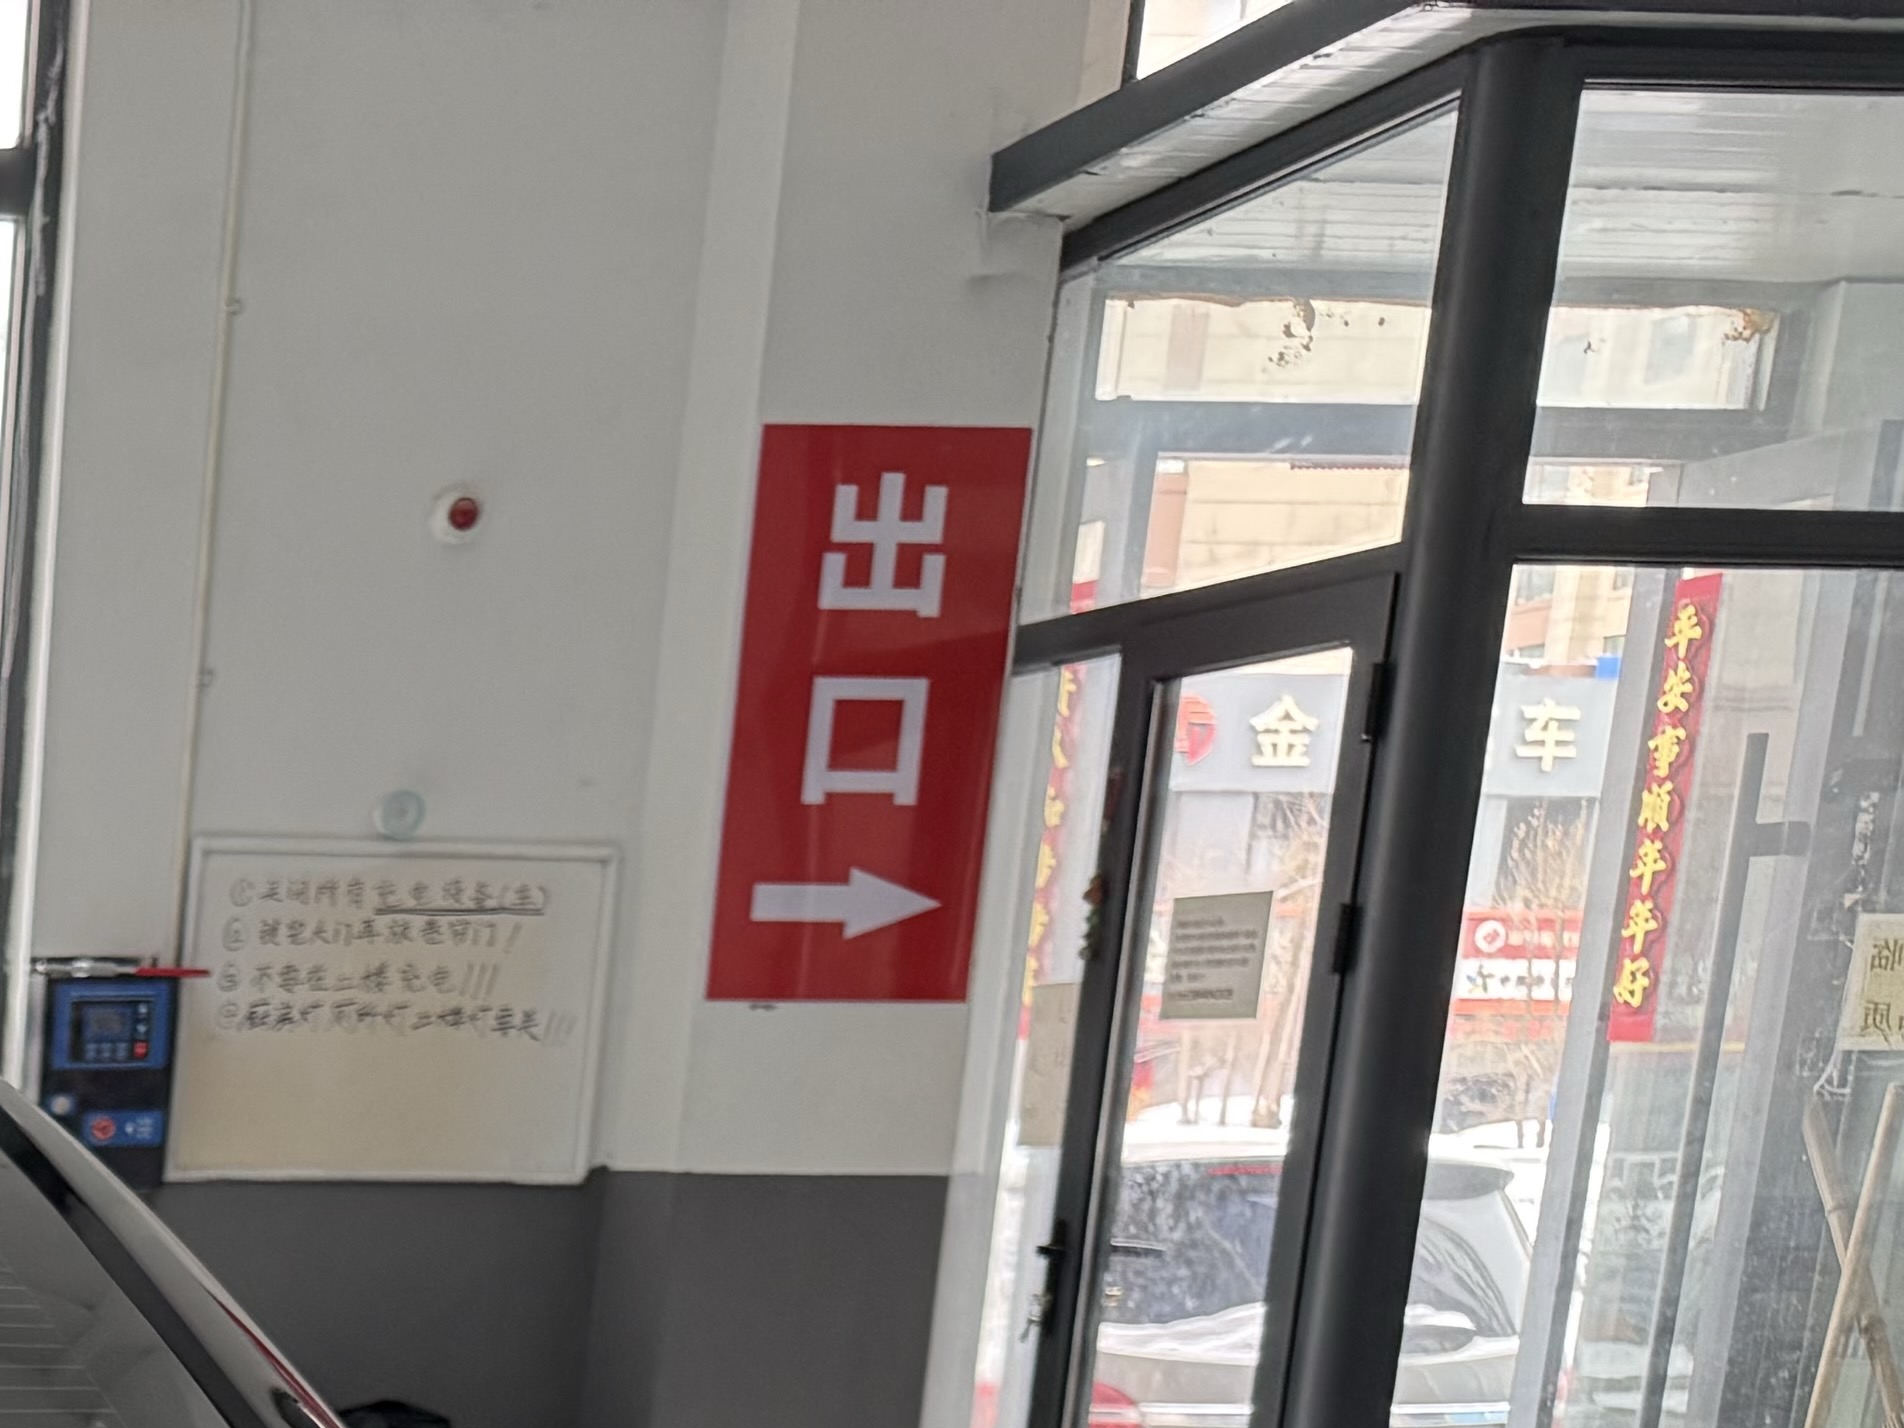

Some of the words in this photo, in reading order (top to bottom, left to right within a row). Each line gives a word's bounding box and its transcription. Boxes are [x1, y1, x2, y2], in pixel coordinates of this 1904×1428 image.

[800, 471, 949, 806] 出口
[1248, 694, 1320, 767] 金
[1514, 697, 1581, 773] 车
